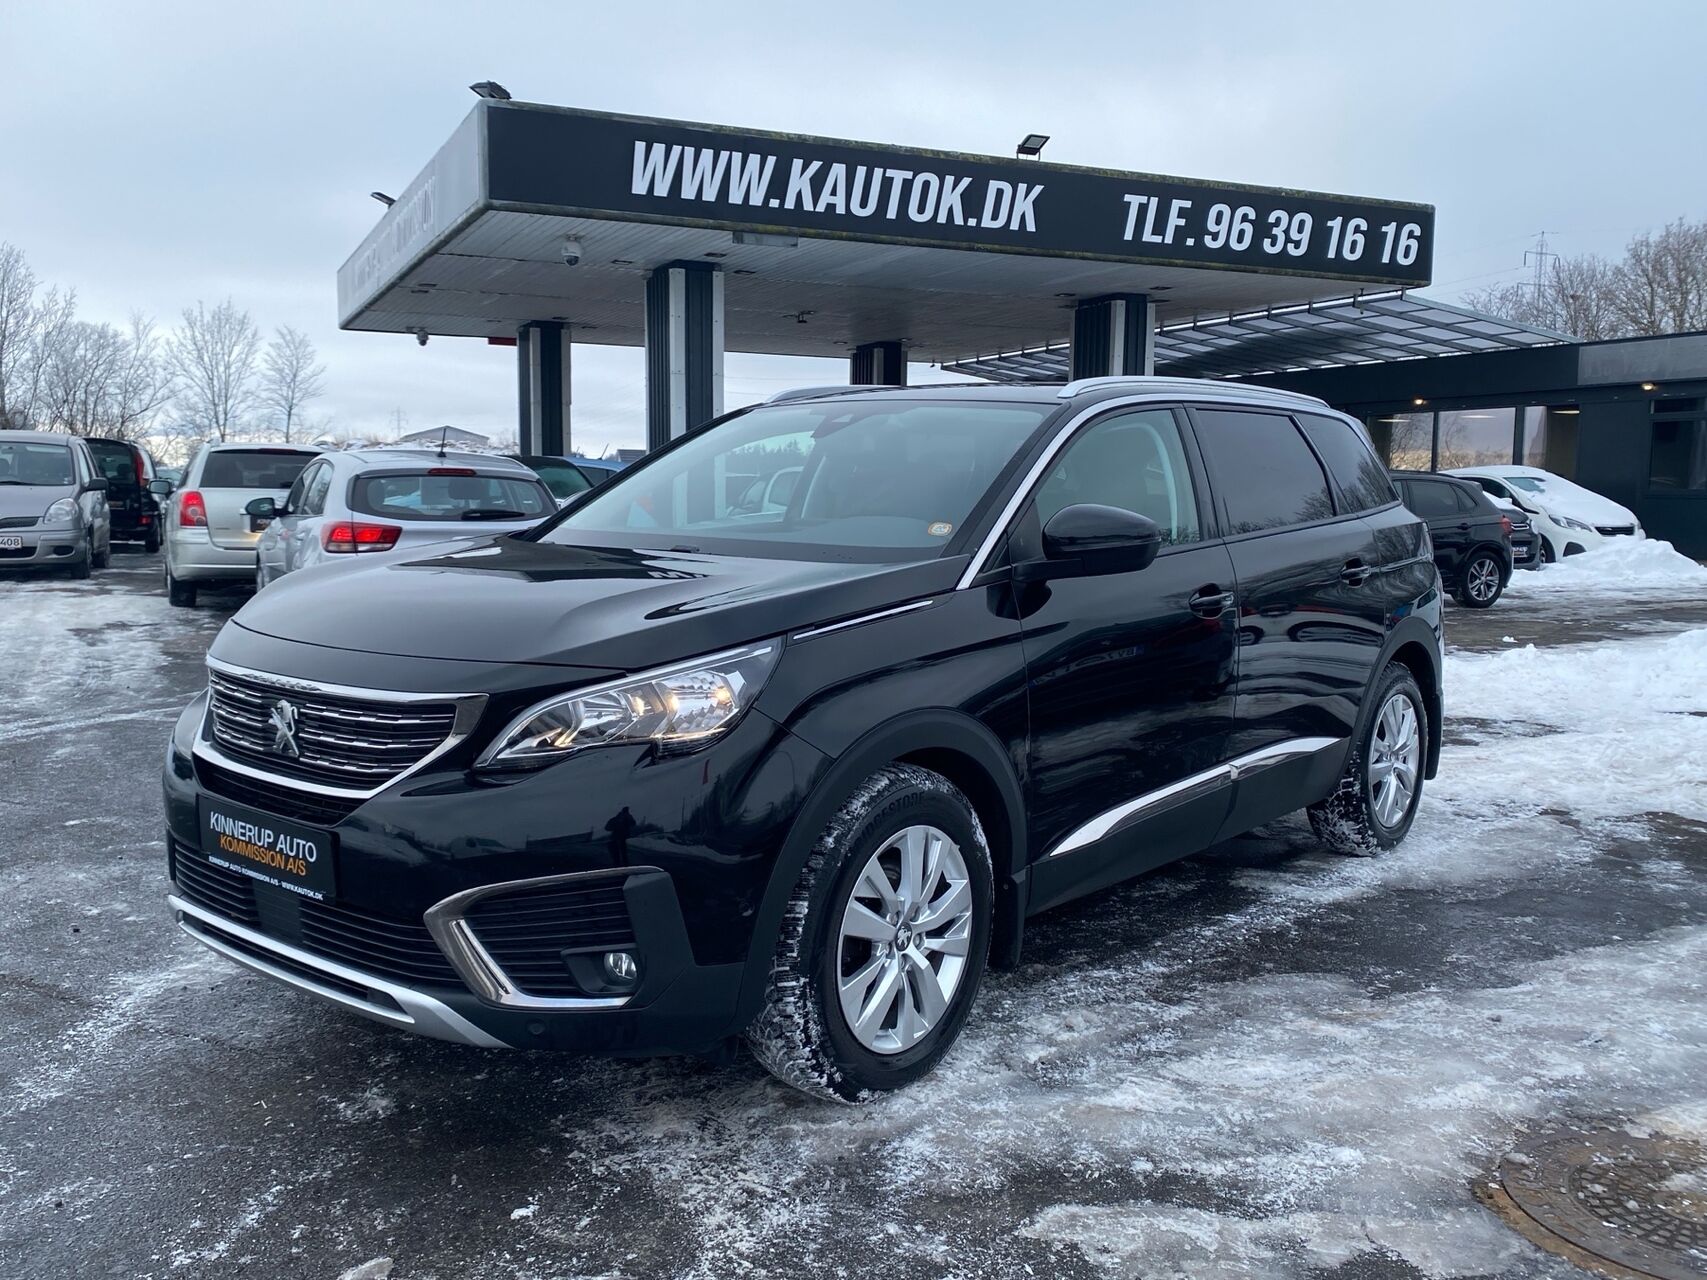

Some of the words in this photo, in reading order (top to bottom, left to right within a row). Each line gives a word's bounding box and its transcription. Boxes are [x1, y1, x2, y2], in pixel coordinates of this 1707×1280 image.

[632, 141, 1045, 232] WWW.KAUTOK.DK
[1123, 194, 1195, 246] TLF.
[1204, 203, 1256, 251] 96
[1263, 209, 1313, 257] 39
[1326, 216, 1368, 261] 16
[1381, 222, 1422, 266] 16
[0, 538, 20, 546] 408
[210, 811, 274, 848] KINNERUP
[276, 834, 317, 863] AUTO
[220, 834, 285, 870] KOMMISSION
[287, 857, 306, 876] A/S
[230, 863, 241, 873] AUTO
